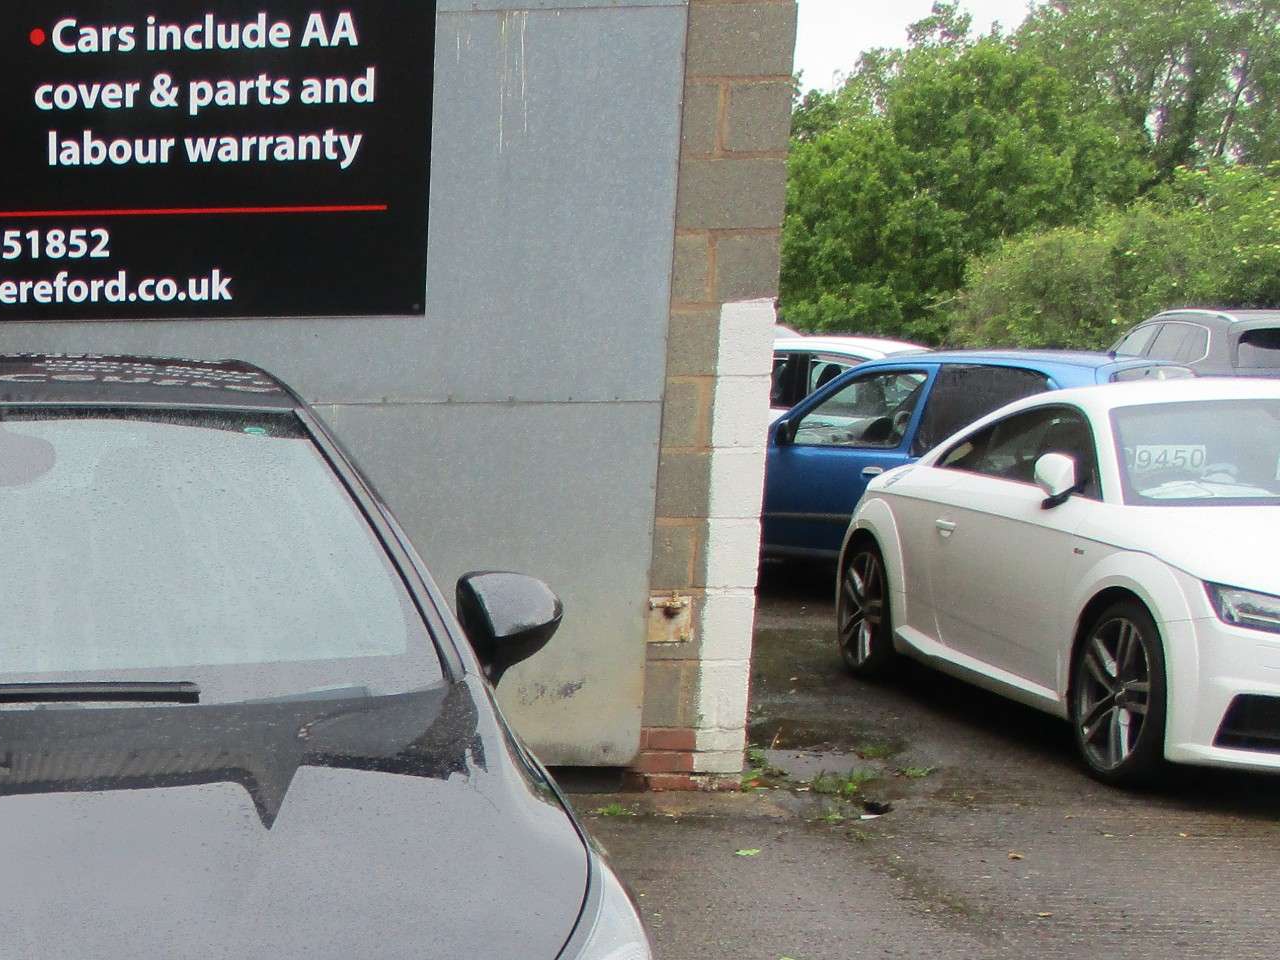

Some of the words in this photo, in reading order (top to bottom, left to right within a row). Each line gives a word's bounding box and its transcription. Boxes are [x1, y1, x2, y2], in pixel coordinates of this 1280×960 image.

[51, 18, 136, 53] Cars
[146, 13, 291, 51] include
[300, 11, 359, 48] AA
[34, 82, 140, 111] cover
[149, 72, 179, 108] &
[189, 72, 291, 116] parts
[300, 66, 375, 105] and
[48, 129, 176, 166] labour
[183, 128, 363, 170] warranty
